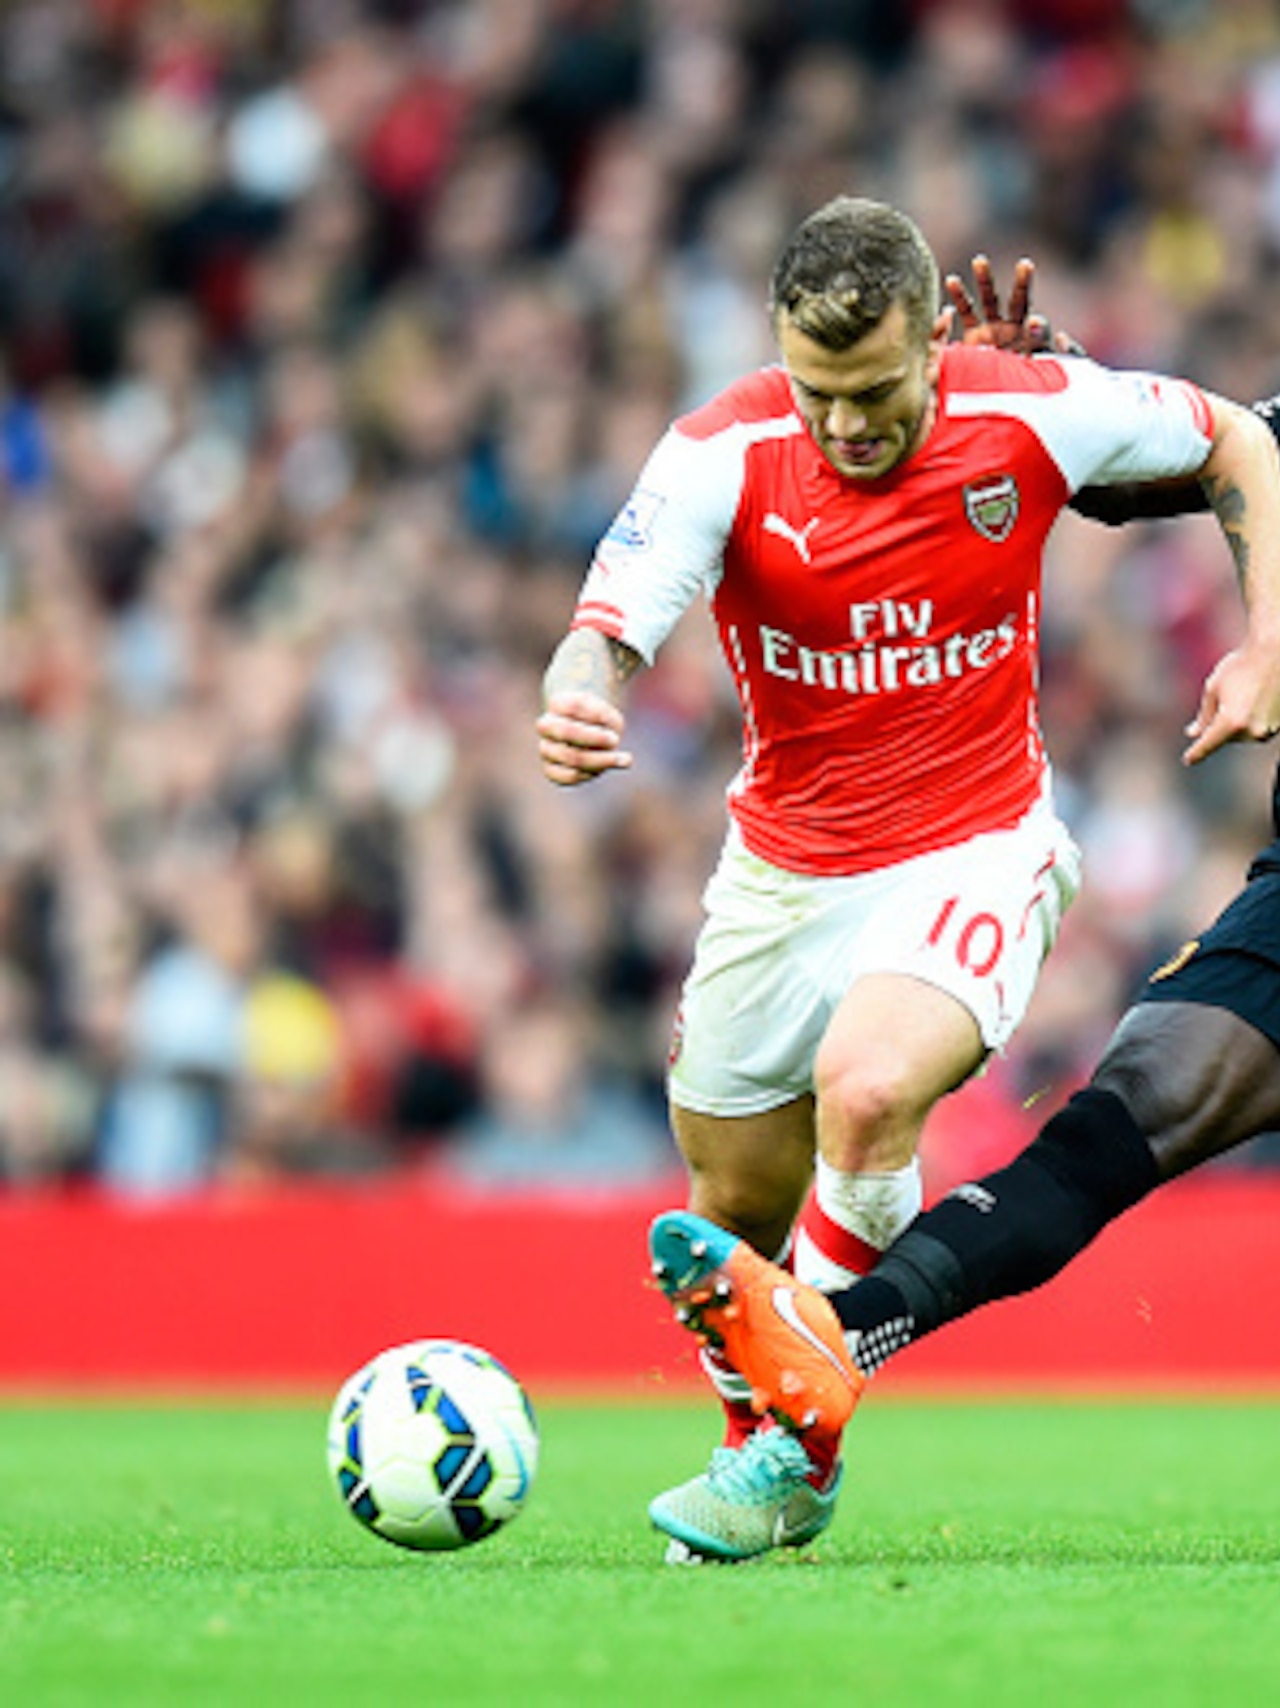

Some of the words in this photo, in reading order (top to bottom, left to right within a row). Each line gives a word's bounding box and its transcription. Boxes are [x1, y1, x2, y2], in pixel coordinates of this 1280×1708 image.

[759, 611, 1017, 693] Emirates
[850, 598, 933, 640] Fly
[926, 895, 1003, 978] 10
